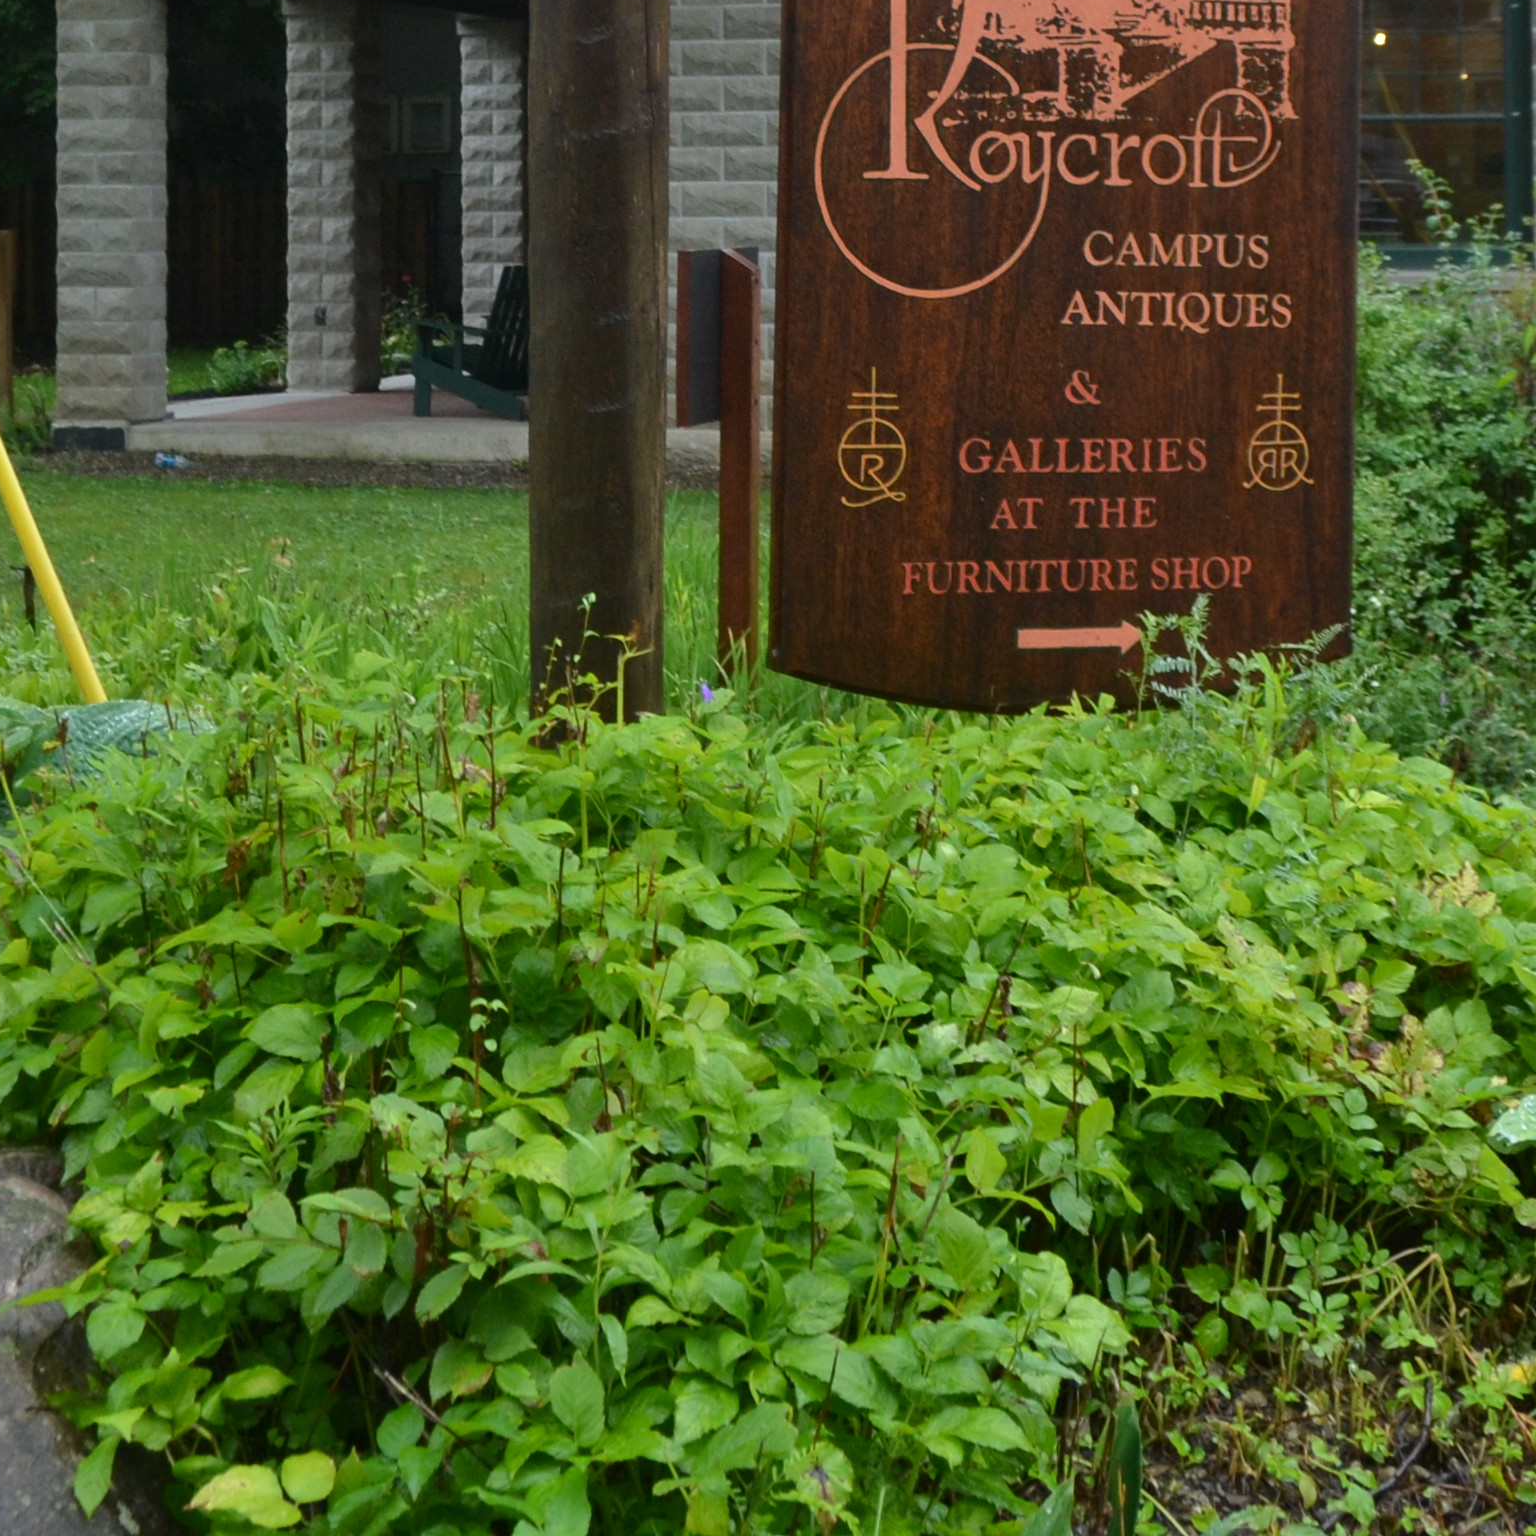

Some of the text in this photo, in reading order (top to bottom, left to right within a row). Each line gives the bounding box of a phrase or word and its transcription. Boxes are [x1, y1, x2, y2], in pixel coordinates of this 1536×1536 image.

[1082, 230, 1270, 268] CAMPUS
[1061, 290, 1293, 334] ANTIQUES
[1064, 370, 1101, 405] &
[958, 437, 1208, 474] GALLERIES
[990, 497, 1158, 530] AT THE
[901, 556, 1253, 596] FURNITURE SHOP
